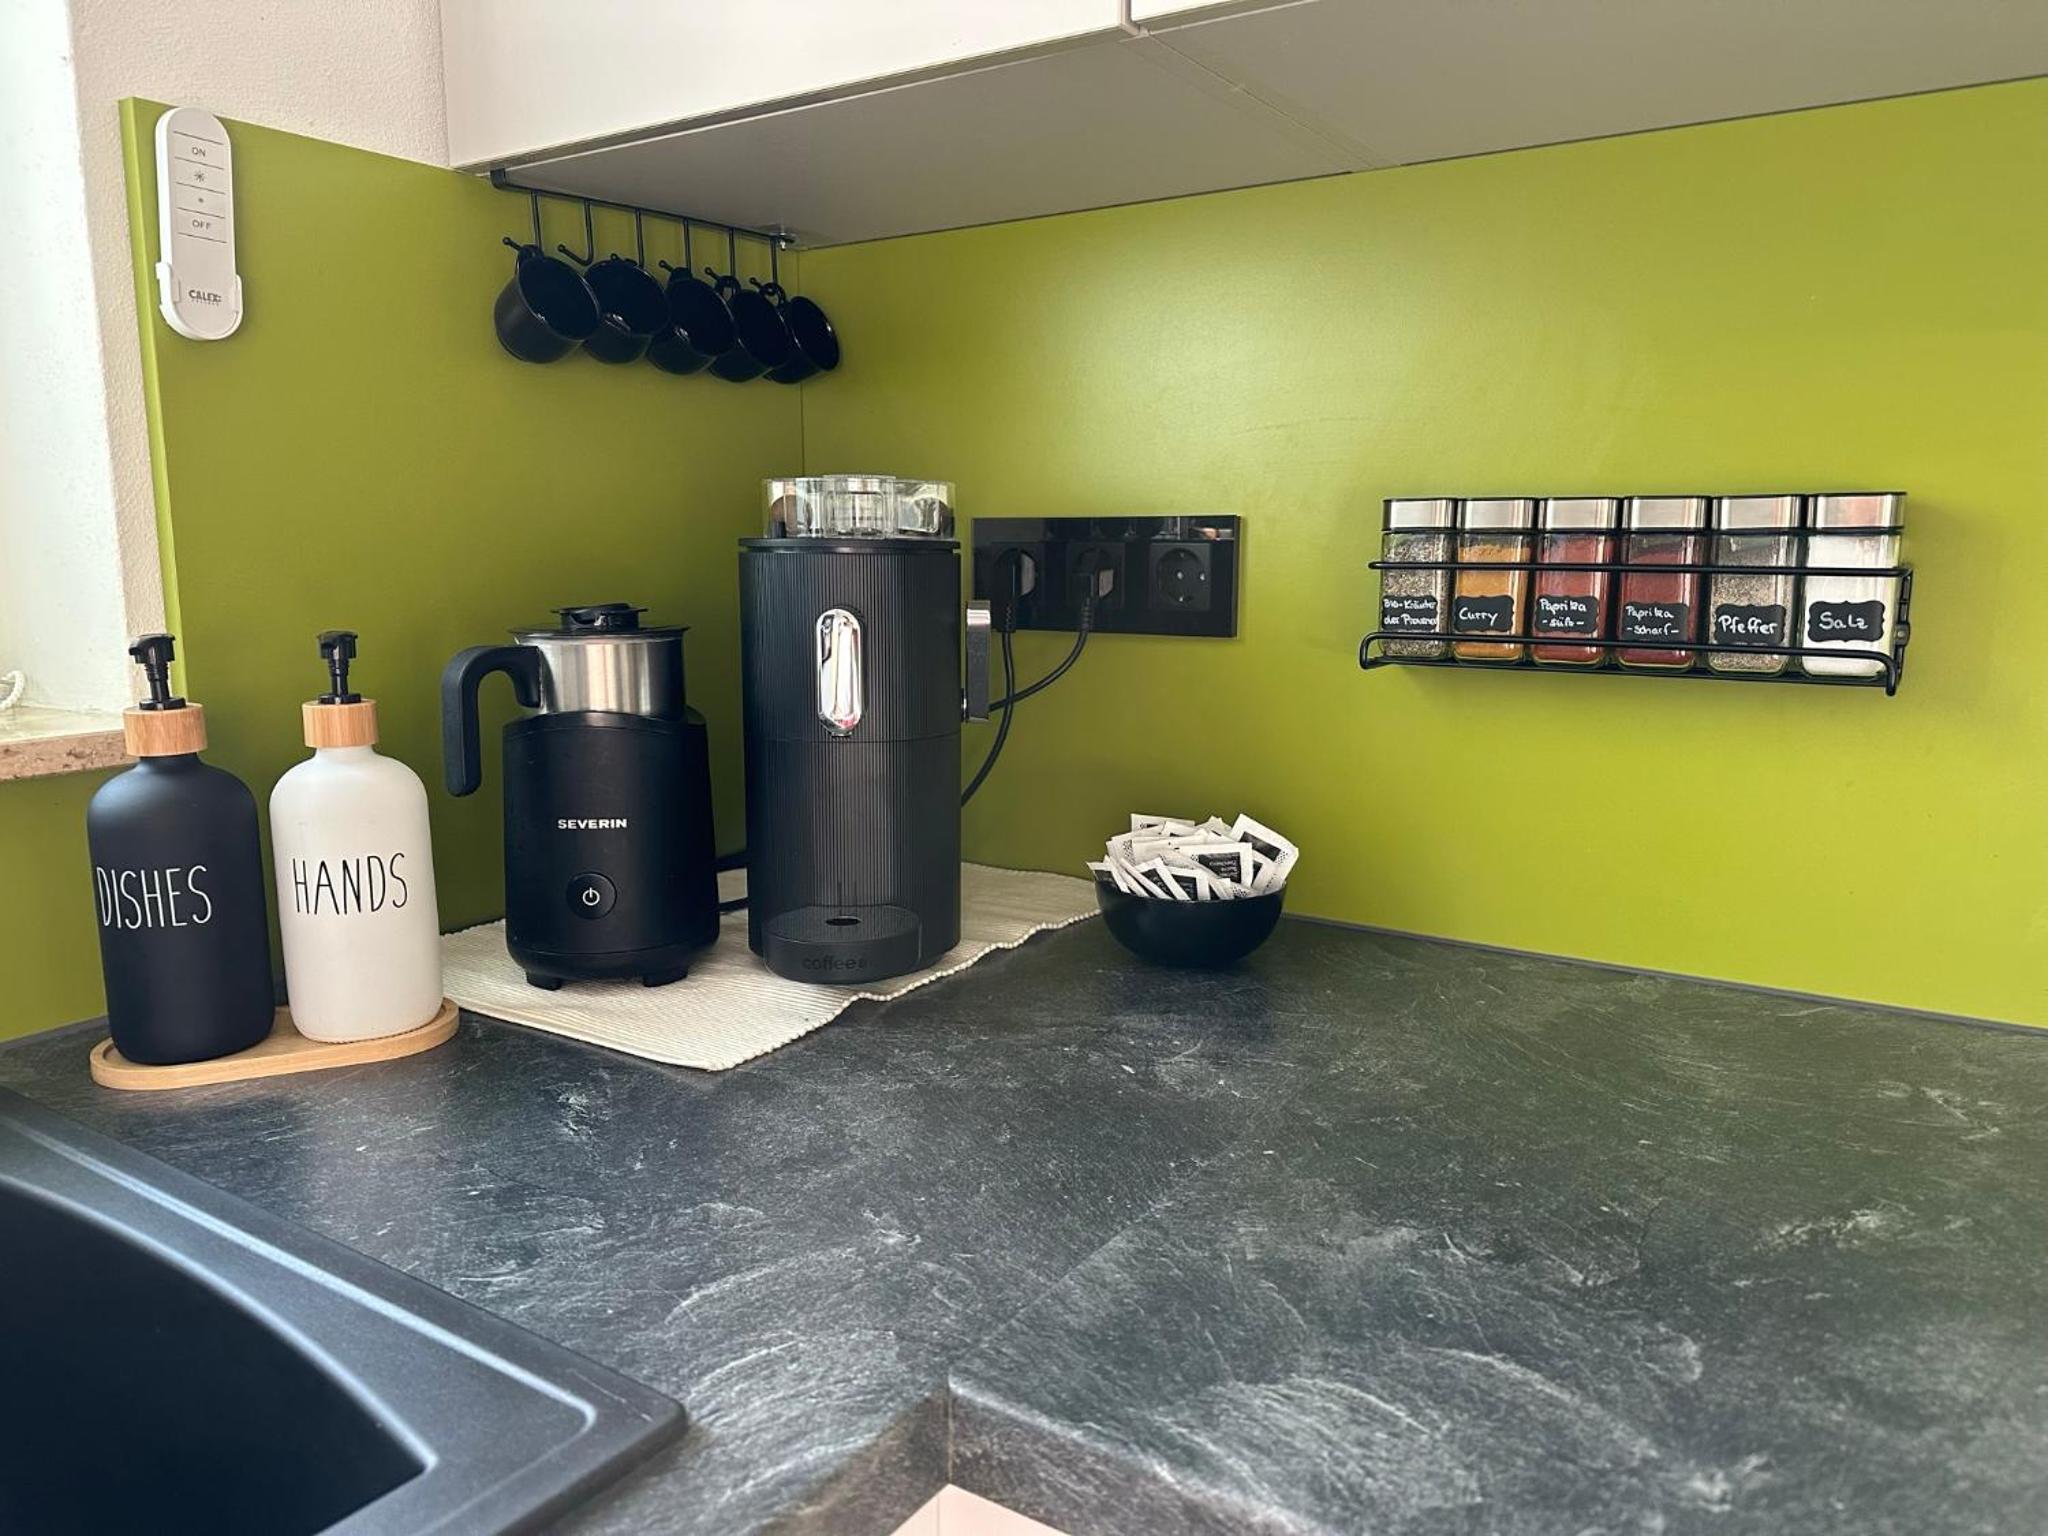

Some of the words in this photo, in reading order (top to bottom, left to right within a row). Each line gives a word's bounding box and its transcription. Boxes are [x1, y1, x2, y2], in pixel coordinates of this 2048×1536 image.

[192, 147, 206, 157] ON
[192, 220, 211, 230] OFF
[1539, 598, 1587, 615] Paprika
[1625, 605, 1675, 621] Paprika
[1459, 607, 1498, 626] Curry
[1718, 615, 1778, 636] Pfeffer
[557, 818, 628, 830] SEVERIN
[293, 852, 408, 916] HANDS
[96, 865, 213, 930] DISHES
